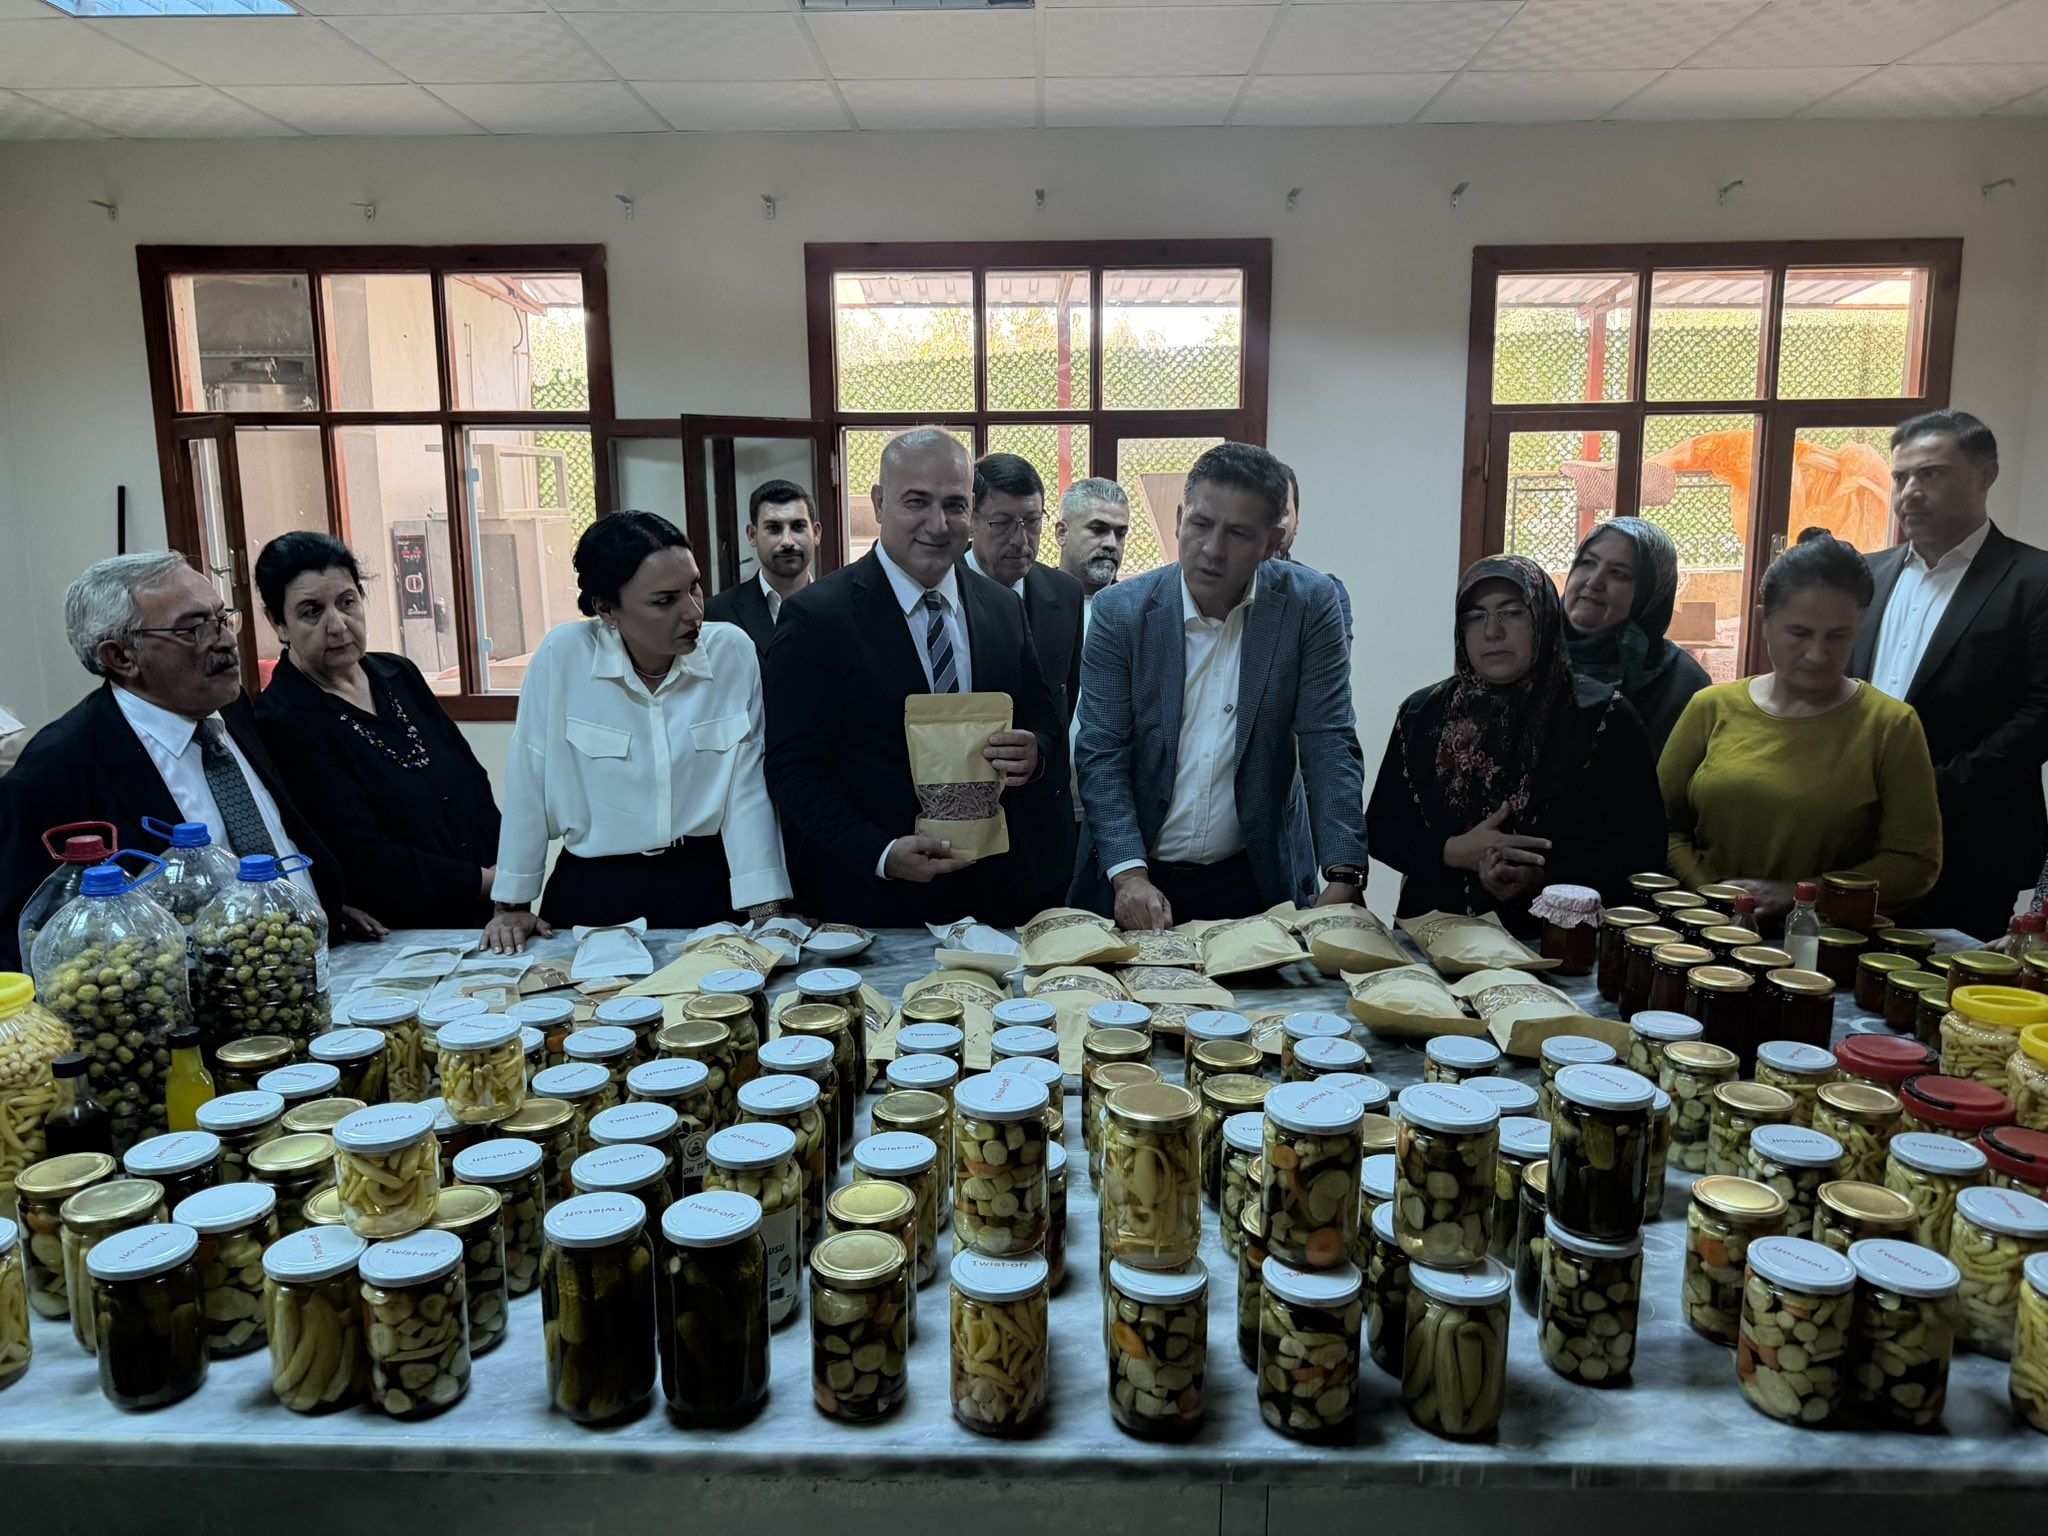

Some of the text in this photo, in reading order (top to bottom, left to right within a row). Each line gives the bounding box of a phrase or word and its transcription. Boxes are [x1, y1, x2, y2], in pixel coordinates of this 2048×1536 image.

[645, 1065, 693, 1077] Twist-off
[904, 1061, 942, 1071] Twist-off
[759, 1079, 797, 1096] Twist-off
[1584, 1070, 1629, 1091] Twist-off
[991, 1078, 1011, 1102] Twist-off
[1296, 1090, 1334, 1109] Twist-off
[1426, 1090, 1473, 1114] Twist-off
[354, 1114, 415, 1127] Twist-off
[608, 1111, 660, 1123] Twist-off
[1510, 1125, 1545, 1138] Twist-off
[731, 1133, 770, 1148] Twist-off
[1770, 1136, 1822, 1144] Twist-off
[155, 1136, 191, 1159] Twist-off
[1911, 1141, 1967, 1154] Twist-off
[471, 1150, 524, 1162] Twist-off
[592, 1154, 644, 1168] Twist-off
[684, 1167, 694, 1175] ON
[565, 1206, 624, 1217] Twist-off
[689, 1203, 736, 1218] Twist-off
[118, 1231, 170, 1261] Twist-off
[308, 1234, 324, 1260] Twist-off
[384, 1248, 439, 1257] Twist-off
[972, 1260, 1028, 1268] Twist-off
[1772, 1246, 1830, 1273] Twist-off
[1877, 1248, 1932, 1277] Twist-off
